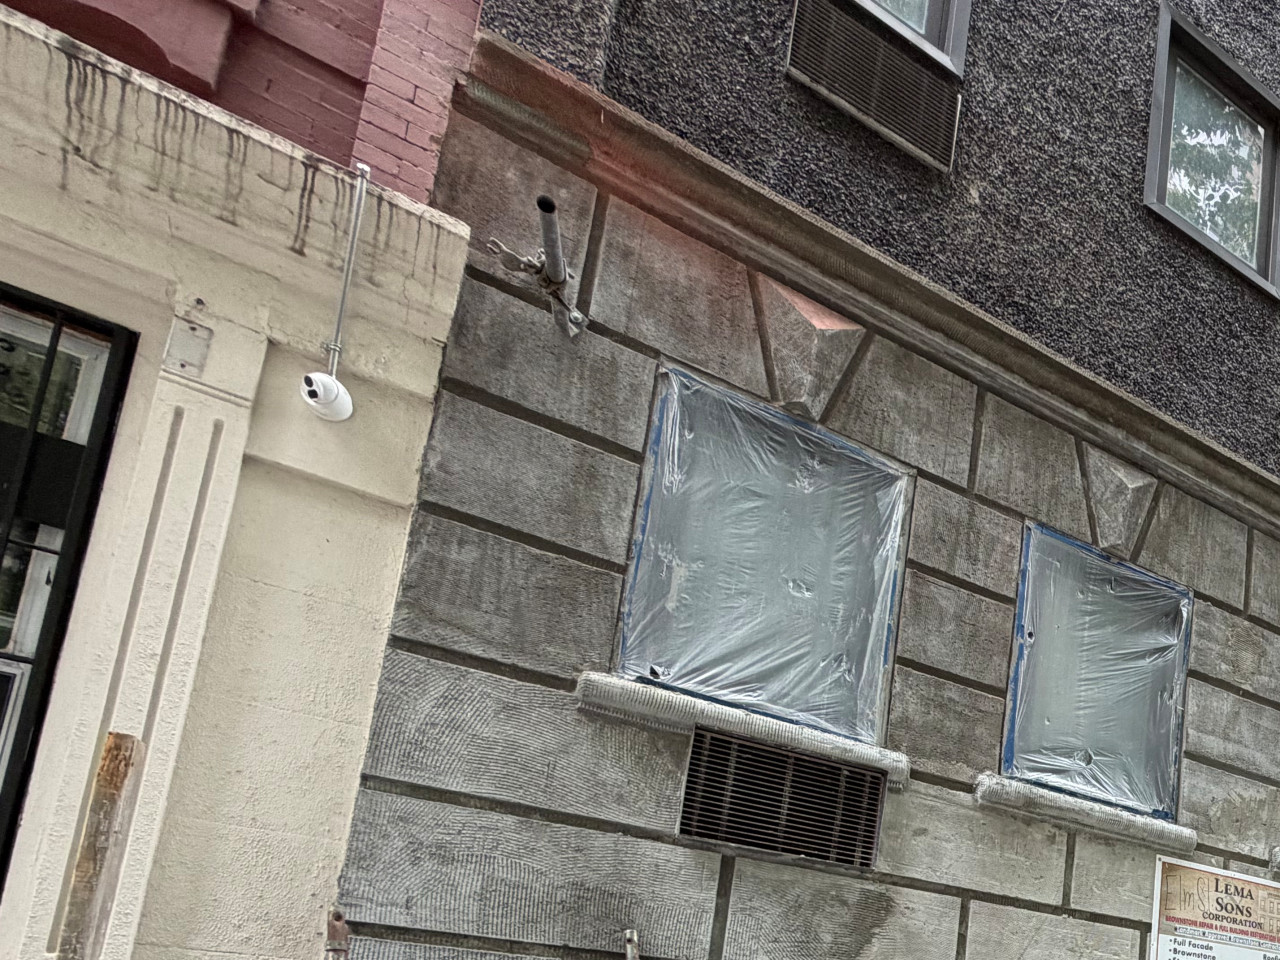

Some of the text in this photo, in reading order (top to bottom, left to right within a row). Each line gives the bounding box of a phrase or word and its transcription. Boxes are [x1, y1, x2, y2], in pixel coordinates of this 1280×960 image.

[1214, 878, 1254, 900] LEMA
[1215, 897, 1252, 918] SONS
[1202, 912, 1263, 930] CORPORATION
[1173, 938, 1213, 951] Full Facade
[1173, 948, 1216, 960] Brownstone
